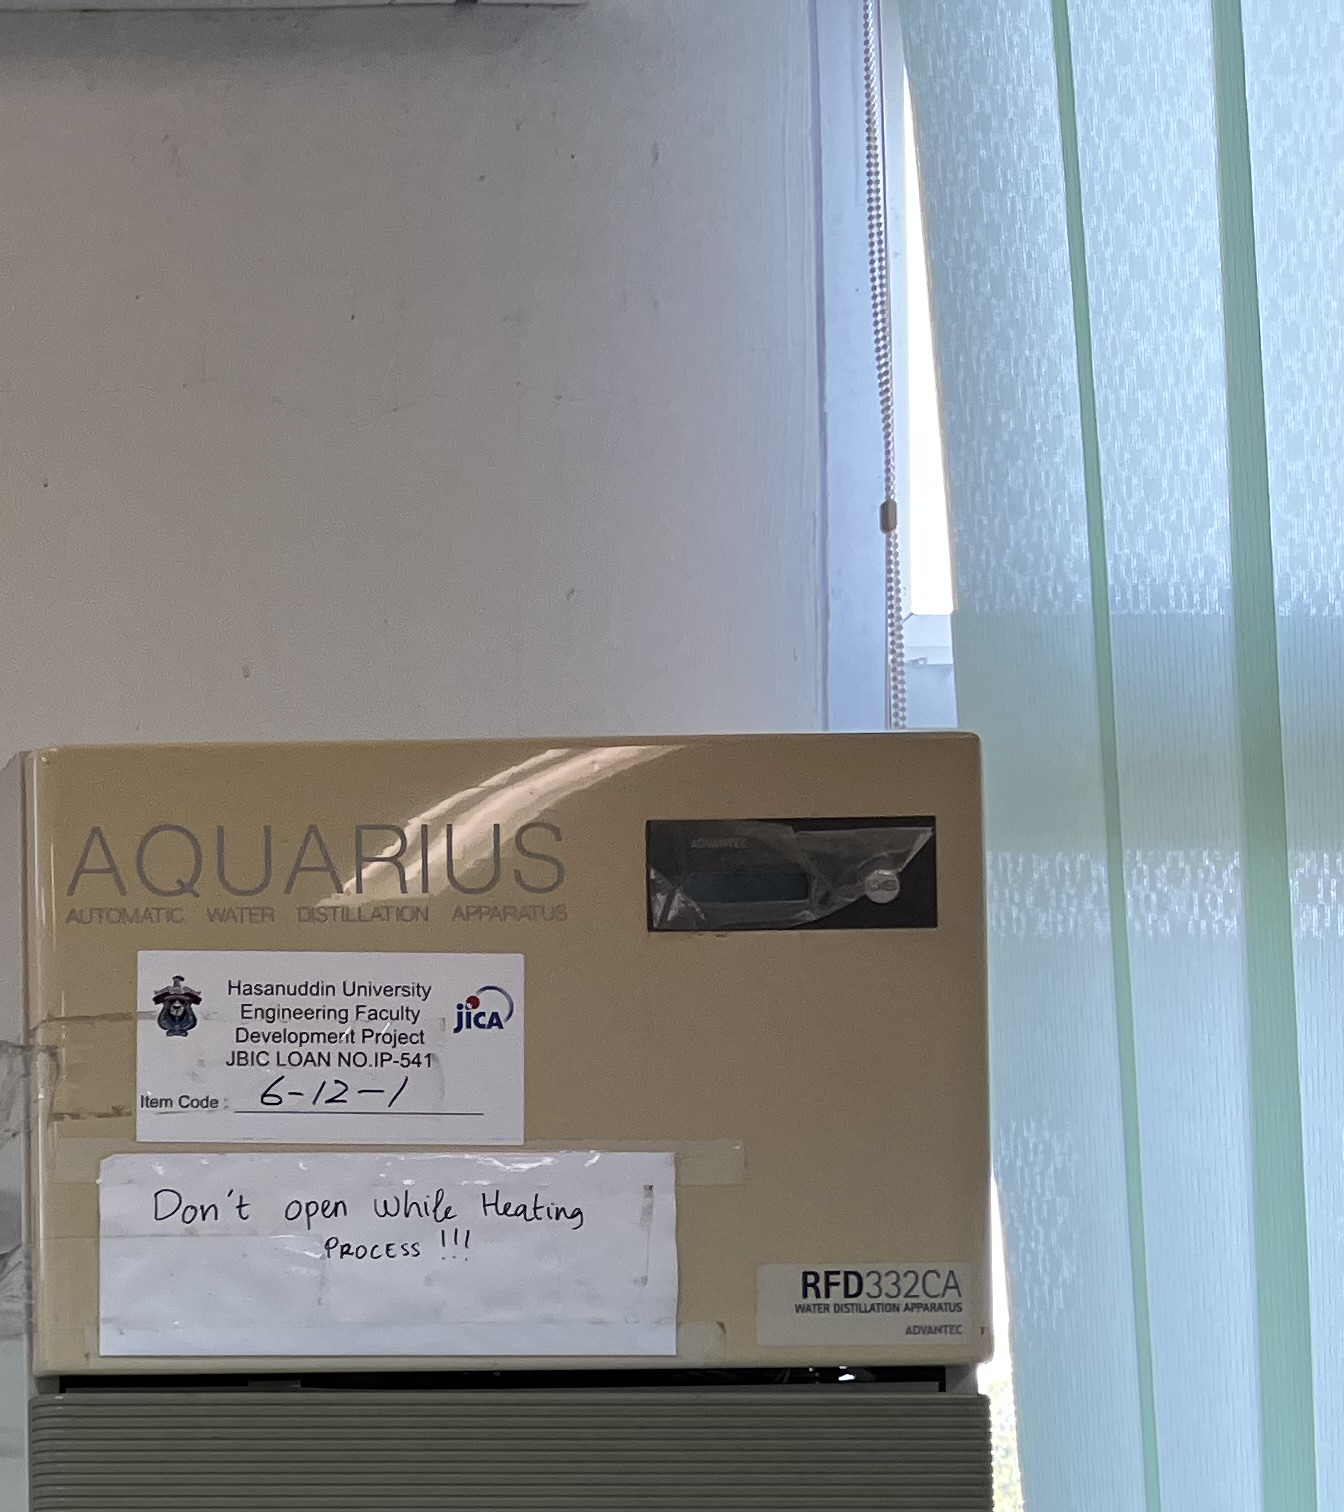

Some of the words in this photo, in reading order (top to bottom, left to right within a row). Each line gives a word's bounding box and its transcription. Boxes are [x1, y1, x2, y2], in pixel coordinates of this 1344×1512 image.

[66, 822, 566, 898] AQUARIUS
[65, 907, 185, 925] AUTOMATIC
[206, 906, 276, 924] WATER
[297, 905, 429, 924] DISTILLATION
[450, 904, 569, 923] APPARATUS
[227, 979, 337, 998] Hasanuddin
[342, 980, 432, 1002] University
[240, 1004, 350, 1025] Engineering
[355, 1005, 421, 1025] Faculty
[235, 1028, 356, 1048] Development
[361, 1029, 425, 1048] Project
[225, 1050, 271, 1068] JBIC
[276, 1051, 332, 1068] LOAN
[337, 1052, 433, 1069] NO.IP-541
[140, 1094, 175, 1109] Item
[153, 1188, 251, 1225] Don't
[284, 1197, 348, 1230] open
[481, 1190, 585, 1230] Heating
[324, 1238, 421, 1261] PROCESS
[801, 1269, 962, 1299] RFD332CA
[794, 1303, 830, 1314] WATER
[833, 1303, 900, 1313] DISTILLATION
[903, 1302, 963, 1313] APPARATUS
[905, 1324, 963, 1335] ADVANTEC
